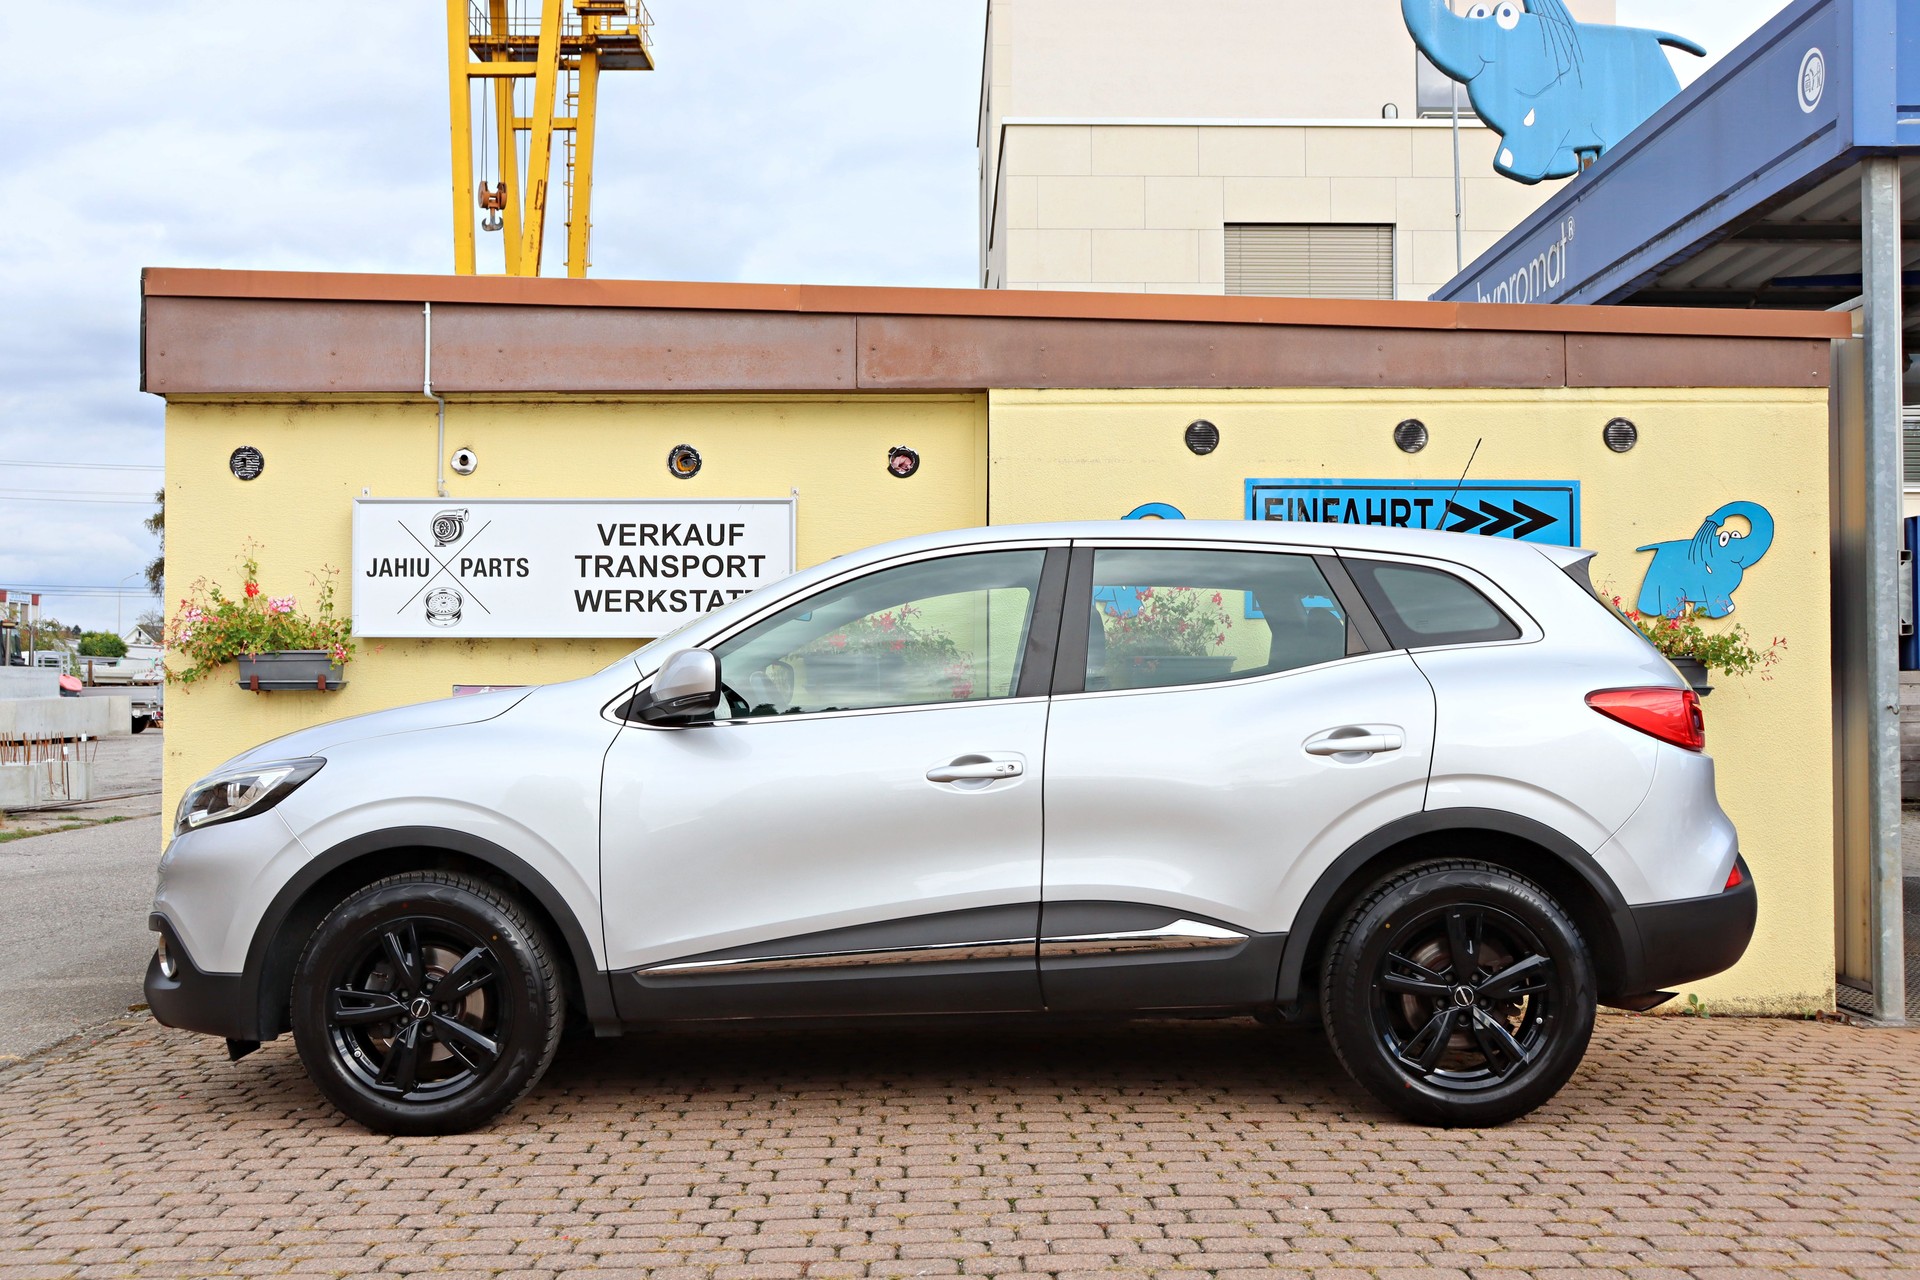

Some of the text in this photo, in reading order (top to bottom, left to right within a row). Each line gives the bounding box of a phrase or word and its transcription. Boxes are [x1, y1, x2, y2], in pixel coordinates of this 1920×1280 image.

[596, 523, 746, 547] VERKAUF
[366, 557, 530, 578] JAHIU PARTS
[574, 554, 767, 579] TRANSPORT
[574, 589, 754, 613] WERKSTAT
